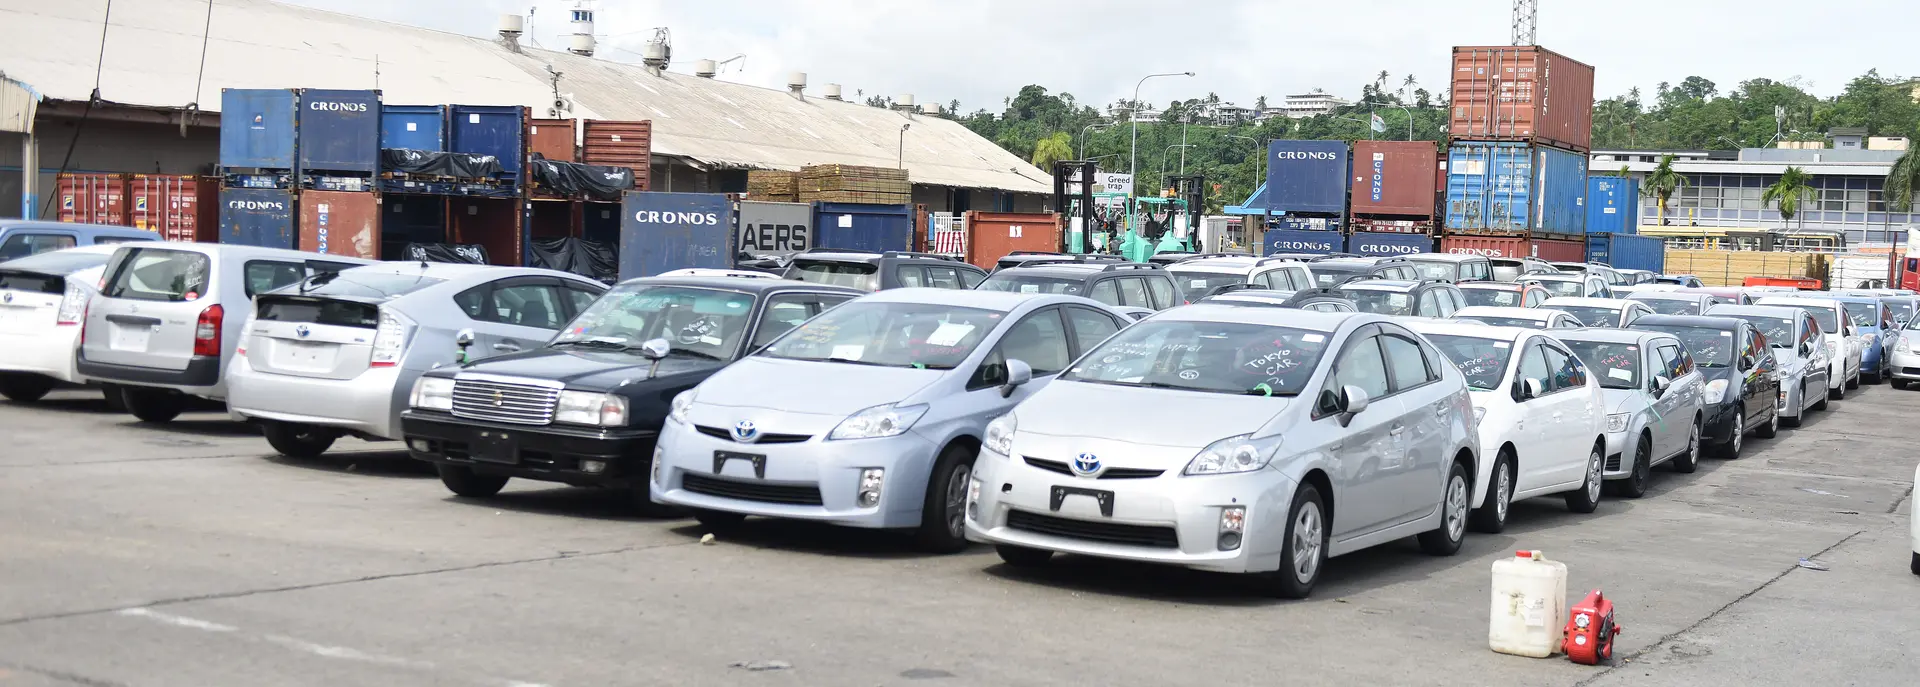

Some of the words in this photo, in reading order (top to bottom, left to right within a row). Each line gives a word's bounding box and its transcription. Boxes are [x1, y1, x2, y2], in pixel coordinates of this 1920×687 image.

[310, 101, 367, 112] CRONOS
[1277, 151, 1336, 160] CRONOS
[1108, 175, 1130, 184] Greed
[1373, 161, 1381, 200] CRONOS
[1108, 183, 1123, 191] trap
[229, 200, 283, 210] CRONOS
[635, 210, 718, 226] CRONOS
[741, 223, 807, 251] AERS
[1274, 240, 1331, 251] CRONOS
[1360, 244, 1420, 253] CRONOS
[1449, 247, 1501, 257] CRONOS
[1244, 349, 1291, 368] TOKYO
[1266, 358, 1299, 376] CAR
[1465, 366, 1486, 376] CAR
